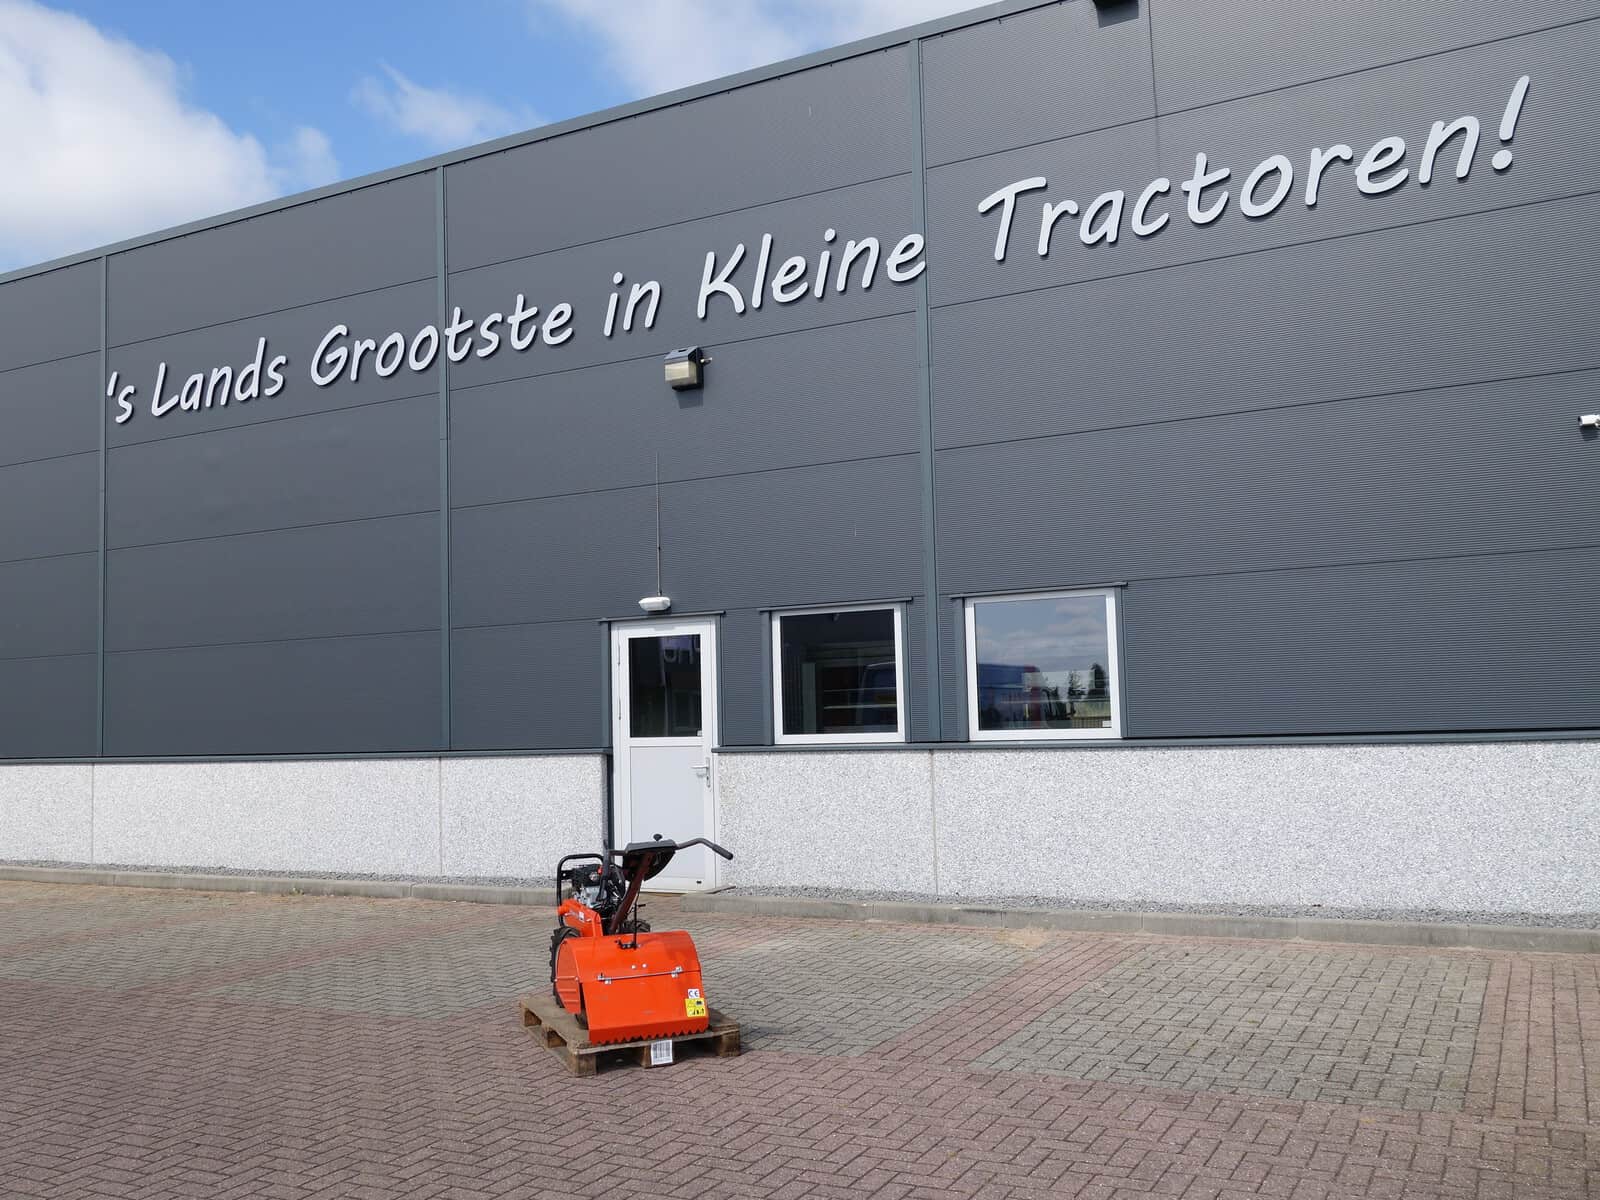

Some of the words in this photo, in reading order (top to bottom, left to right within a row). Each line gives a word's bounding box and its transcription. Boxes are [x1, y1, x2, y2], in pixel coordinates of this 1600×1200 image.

[106, 371, 135, 424] 's
[151, 336, 287, 417] Lands
[310, 293, 573, 386] Grootste
[603, 271, 660, 337] in
[697, 227, 926, 319] Kleine
[977, 74, 1530, 261] Tractoren!
